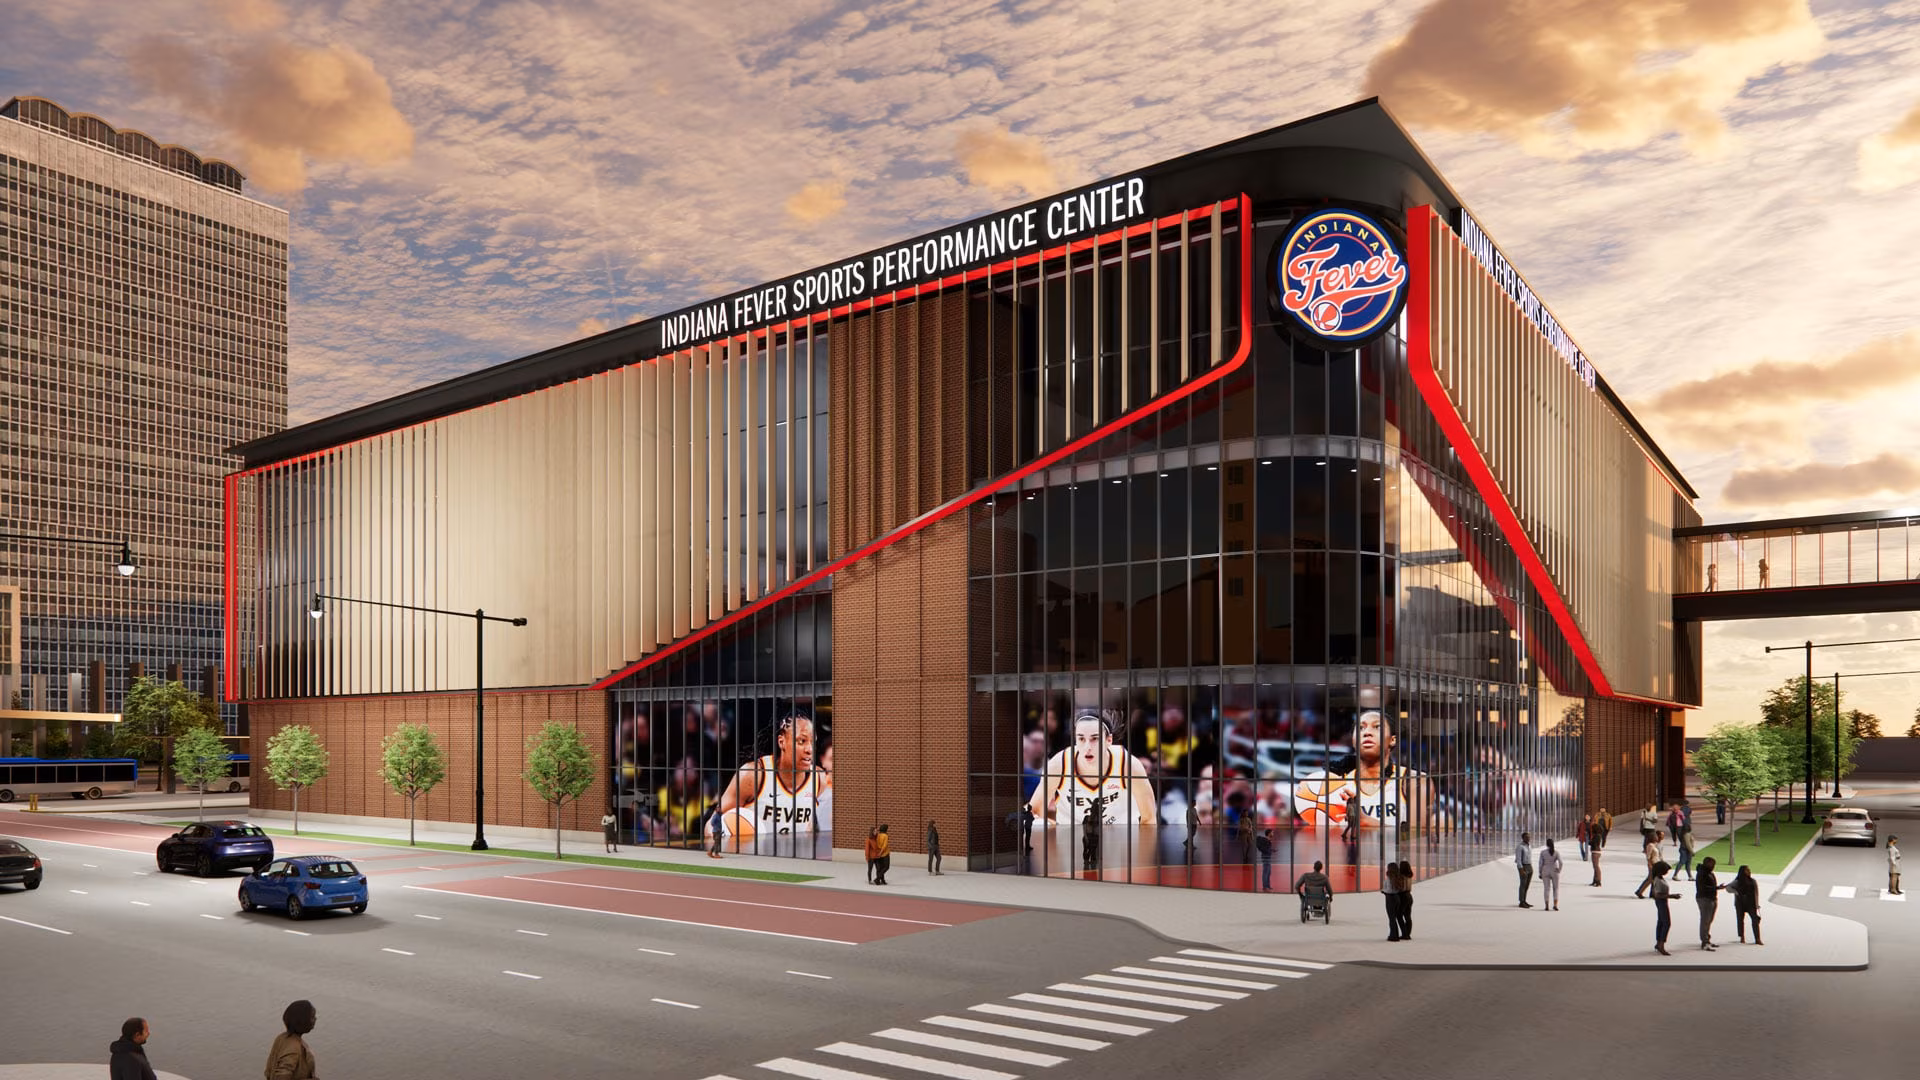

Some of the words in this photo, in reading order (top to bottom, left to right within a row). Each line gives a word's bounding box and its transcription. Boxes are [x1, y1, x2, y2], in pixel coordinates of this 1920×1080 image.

[661, 308, 729, 349] INDIANA
[734, 283, 787, 329] FEVER
[792, 261, 866, 313] SPORTS
[873, 208, 1038, 291] PERFORMANCE
[1047, 177, 1145, 241] CENTER
[1297, 221, 1380, 251] INDIANA
[1461, 207, 1494, 277] INDIANA
[1283, 243, 1406, 312] Fever
[763, 805, 811, 823] FEVER
